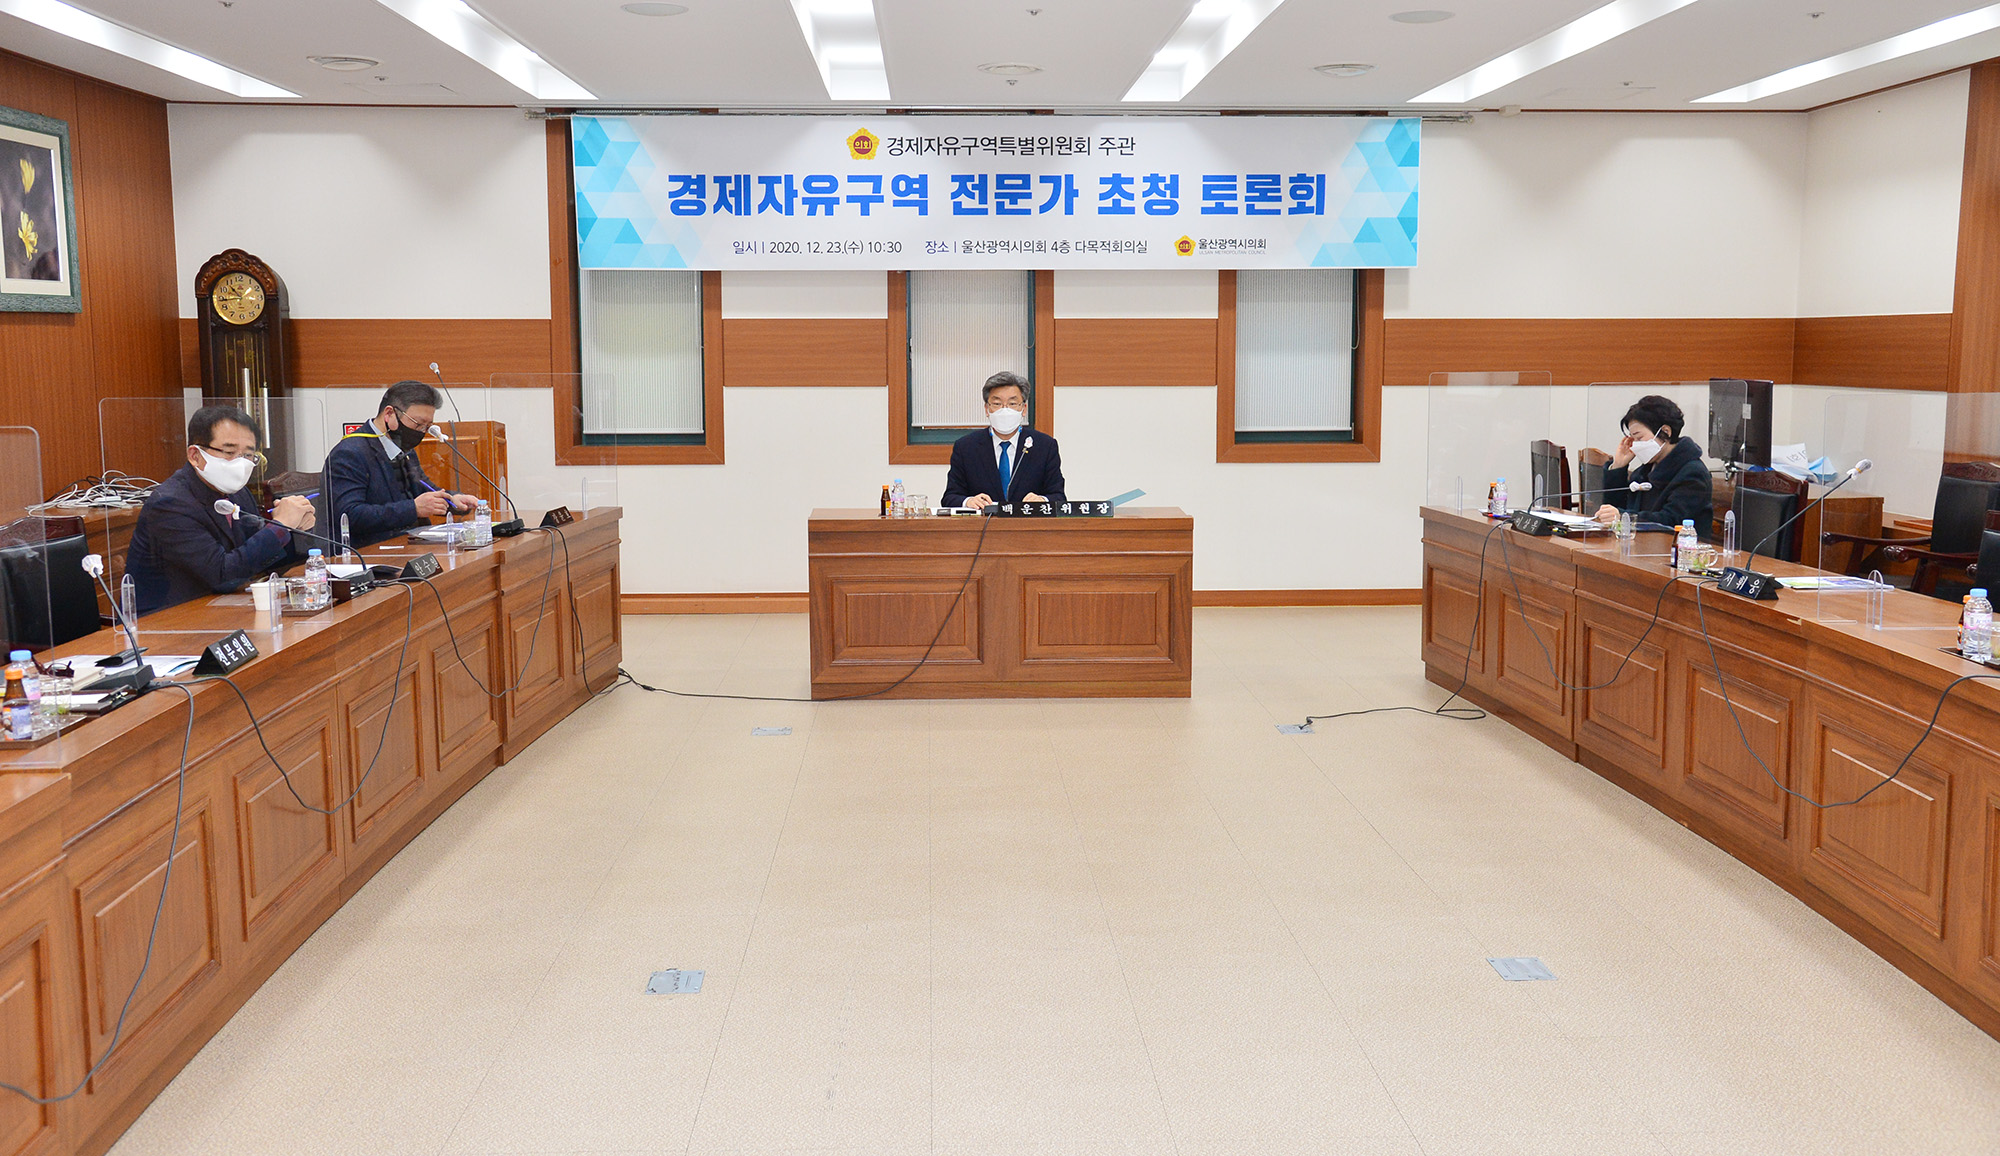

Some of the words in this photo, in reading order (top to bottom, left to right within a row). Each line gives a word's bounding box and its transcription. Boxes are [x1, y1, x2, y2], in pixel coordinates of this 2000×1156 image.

[854, 140, 872, 150] 의회
[887, 137, 1091, 156] 경제자유구역특별위원회
[1098, 137, 1136, 156] 주관
[668, 174, 929, 216] 경제자유구역
[950, 173, 1079, 216] 전문가
[1097, 172, 1180, 216] 초청
[1200, 173, 1327, 216] 토론회
[732, 240, 758, 255] 일시
[769, 241, 803, 254] 2020.
[806, 241, 824, 254] 12.
[868, 241, 903, 254] 10:30
[925, 240, 950, 255] 장소
[961, 240, 1047, 255] 울산광역시의회
[1051, 240, 1071, 255] 4층
[1075, 240, 1148, 255] 다목적회의실
[1198, 239, 1267, 249] 울산광역시의회
[1060, 502, 1110, 515] 위원장
[214, 633, 256, 667] 전문위원
